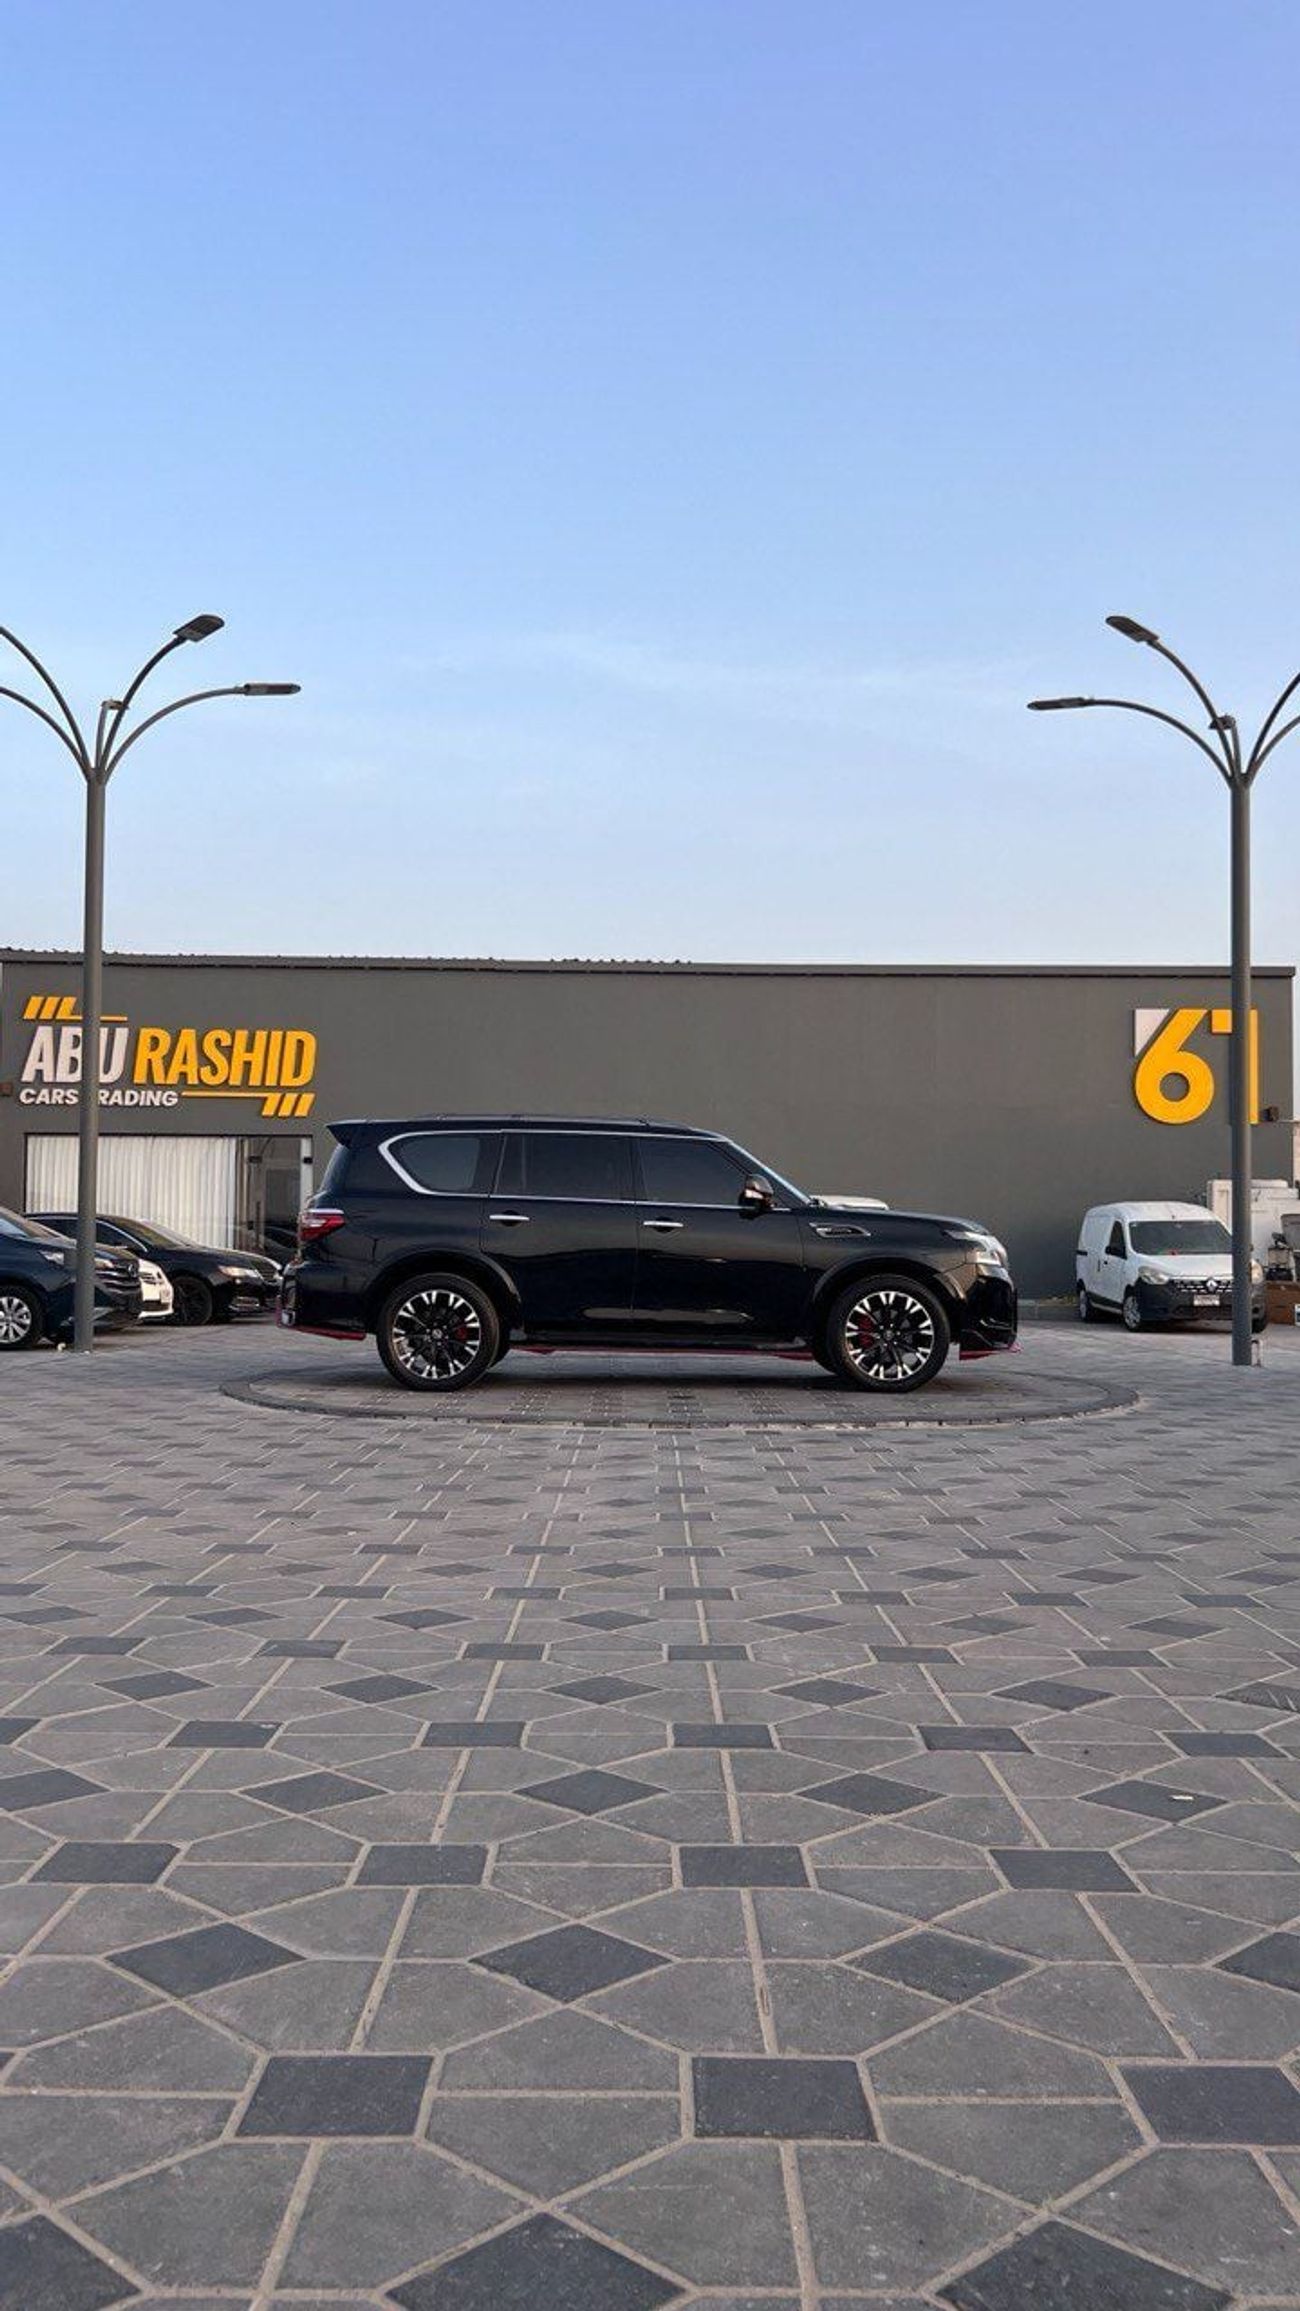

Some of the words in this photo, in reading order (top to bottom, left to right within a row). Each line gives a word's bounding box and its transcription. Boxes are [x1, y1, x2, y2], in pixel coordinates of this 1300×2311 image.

[20, 1025, 130, 1084] ABU
[133, 1027, 317, 1087] RASHID
[19, 1088, 80, 1105] CARS
[97, 1089, 179, 1107] RADING
